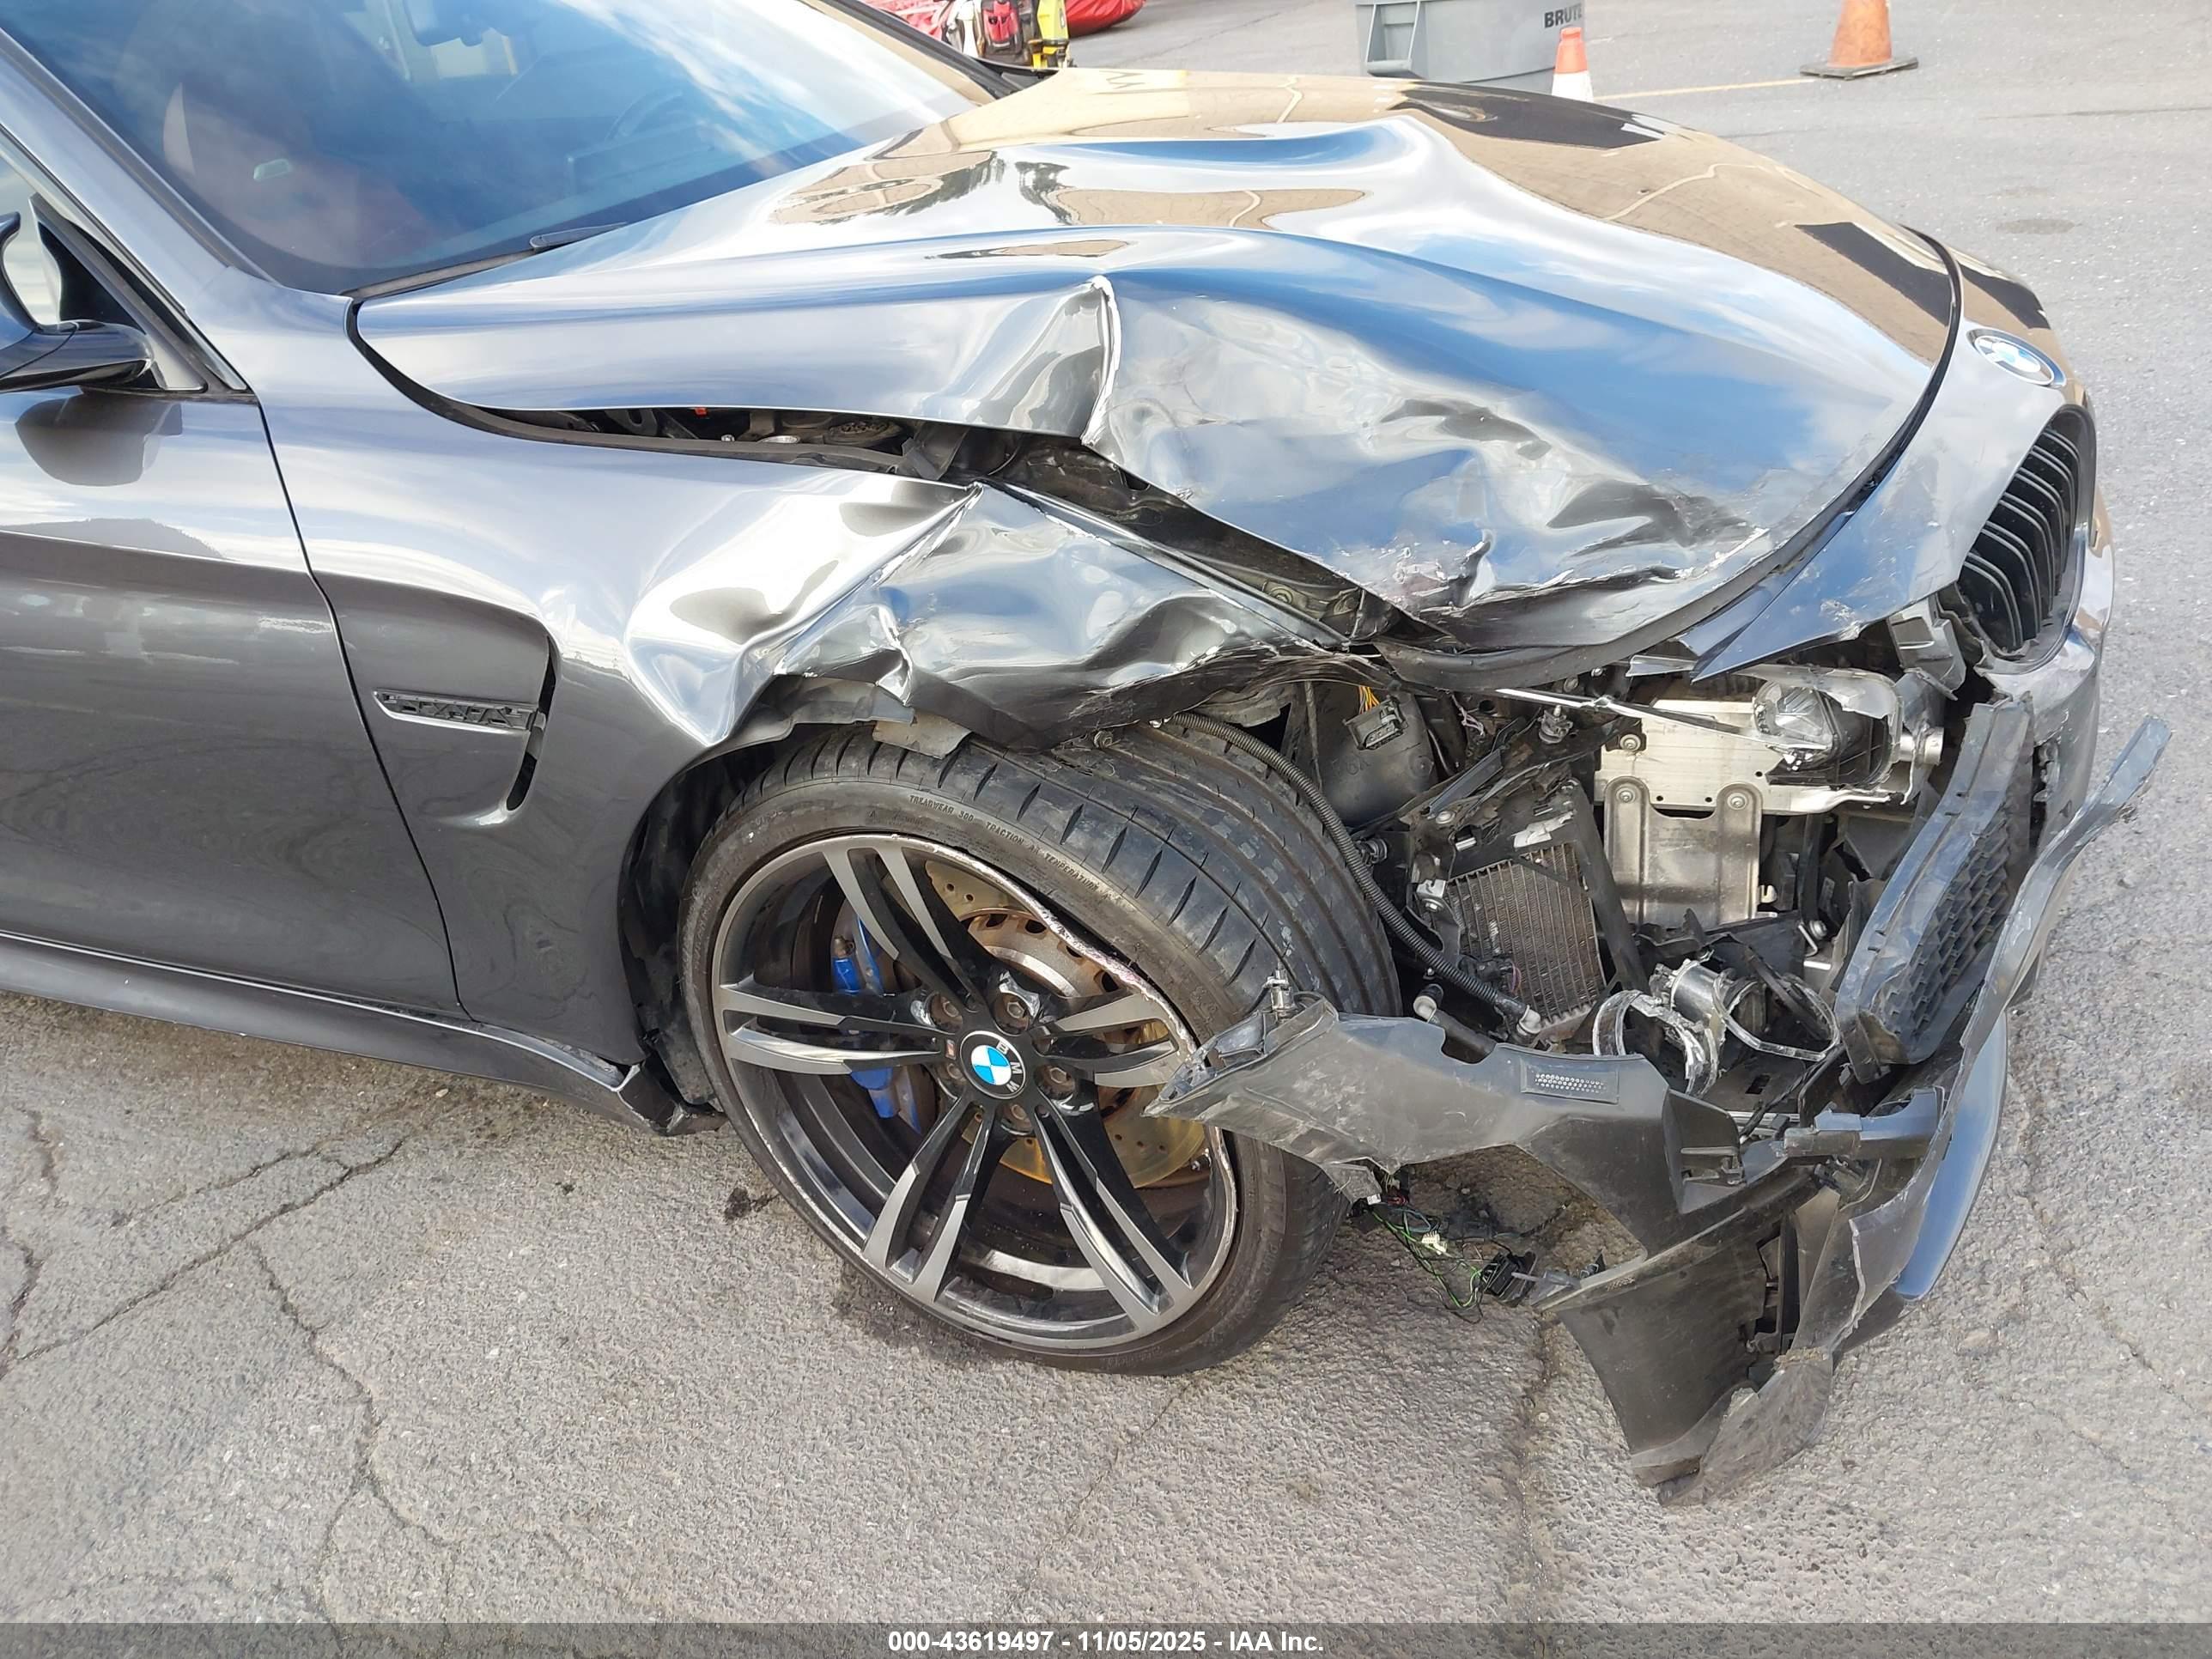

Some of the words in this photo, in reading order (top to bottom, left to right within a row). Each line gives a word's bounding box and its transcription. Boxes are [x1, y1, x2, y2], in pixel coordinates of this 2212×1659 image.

[910, 794, 955, 815] TREADWEAR
[958, 810, 975, 823] 300
[985, 821, 1025, 846] TRACTION
[996, 1040, 1023, 1093] BMW
